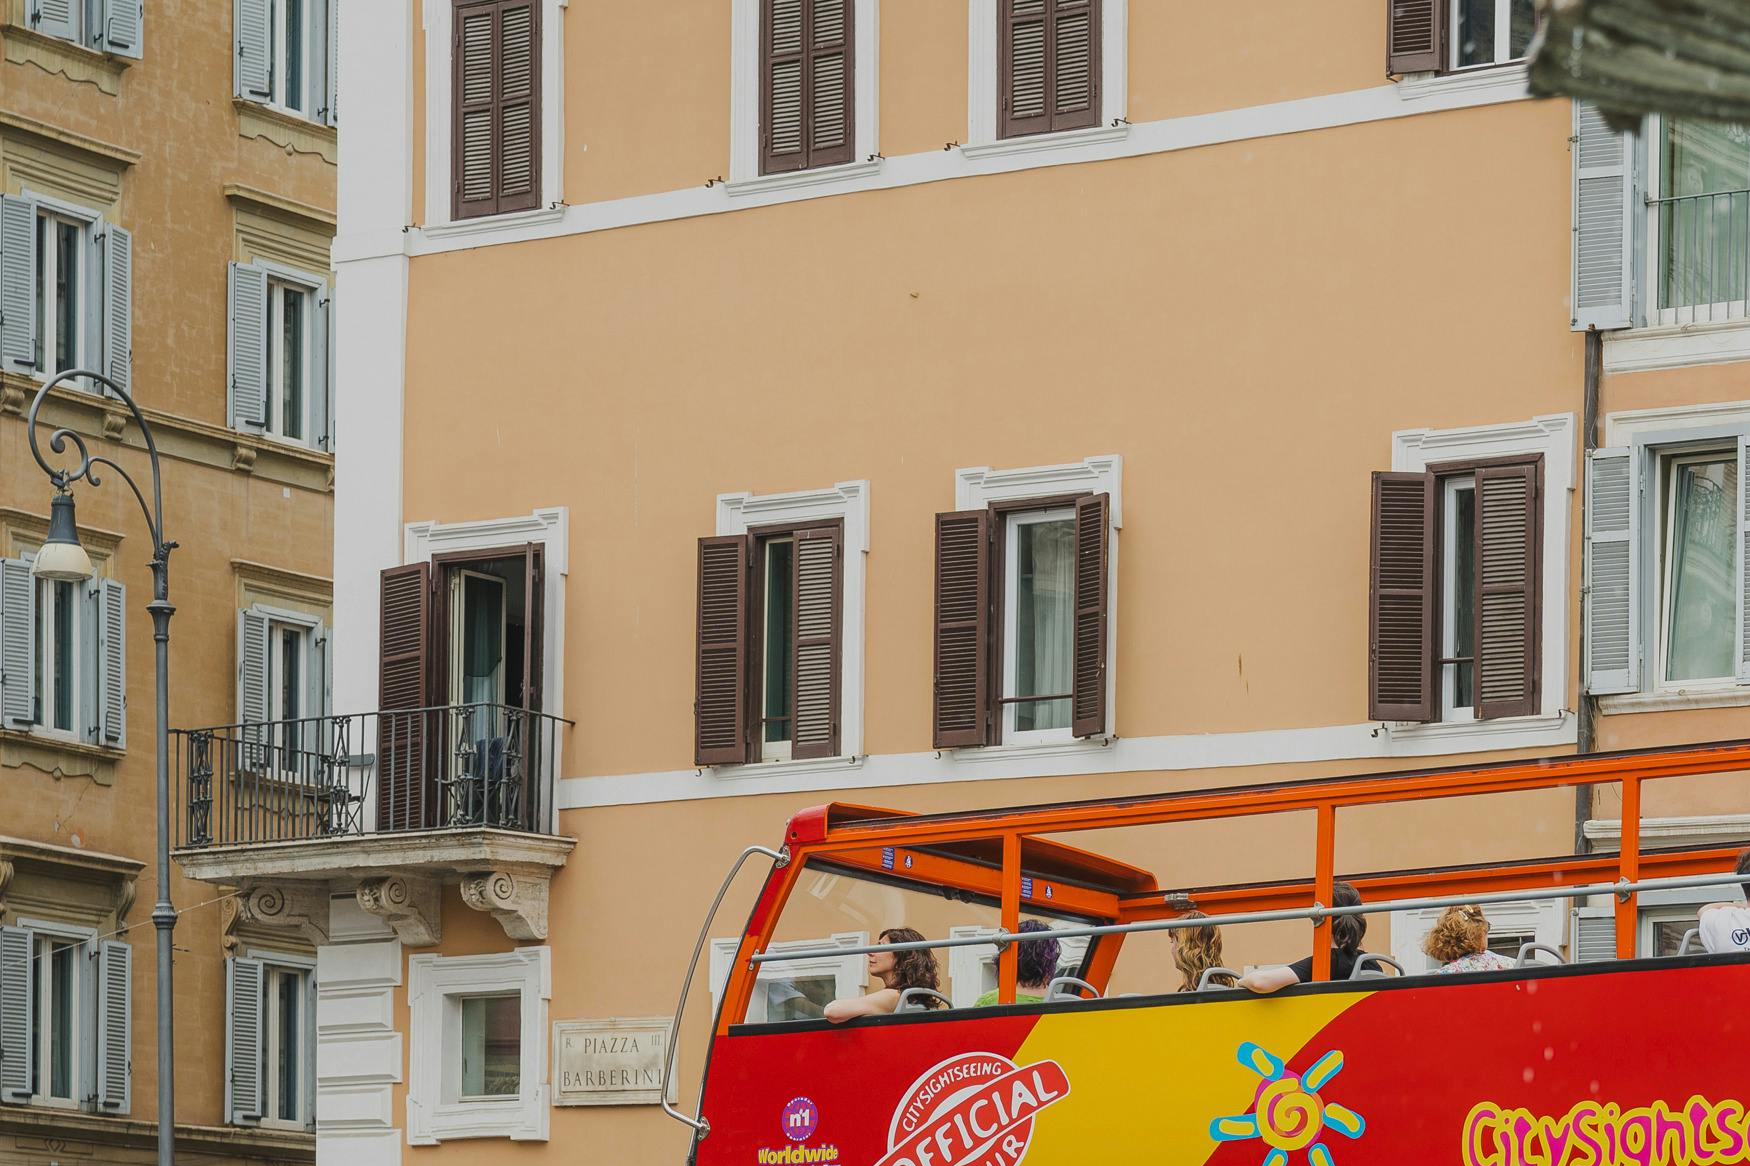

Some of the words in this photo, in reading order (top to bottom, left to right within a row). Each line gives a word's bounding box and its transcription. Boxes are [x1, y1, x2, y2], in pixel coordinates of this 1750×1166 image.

[584, 1037, 639, 1054] PIAZZA
[563, 1069, 661, 1086] BARBERINI
[902, 1062, 1002, 1132] CITYSIGHTSEEING
[758, 1144, 839, 1165] Worldwide
